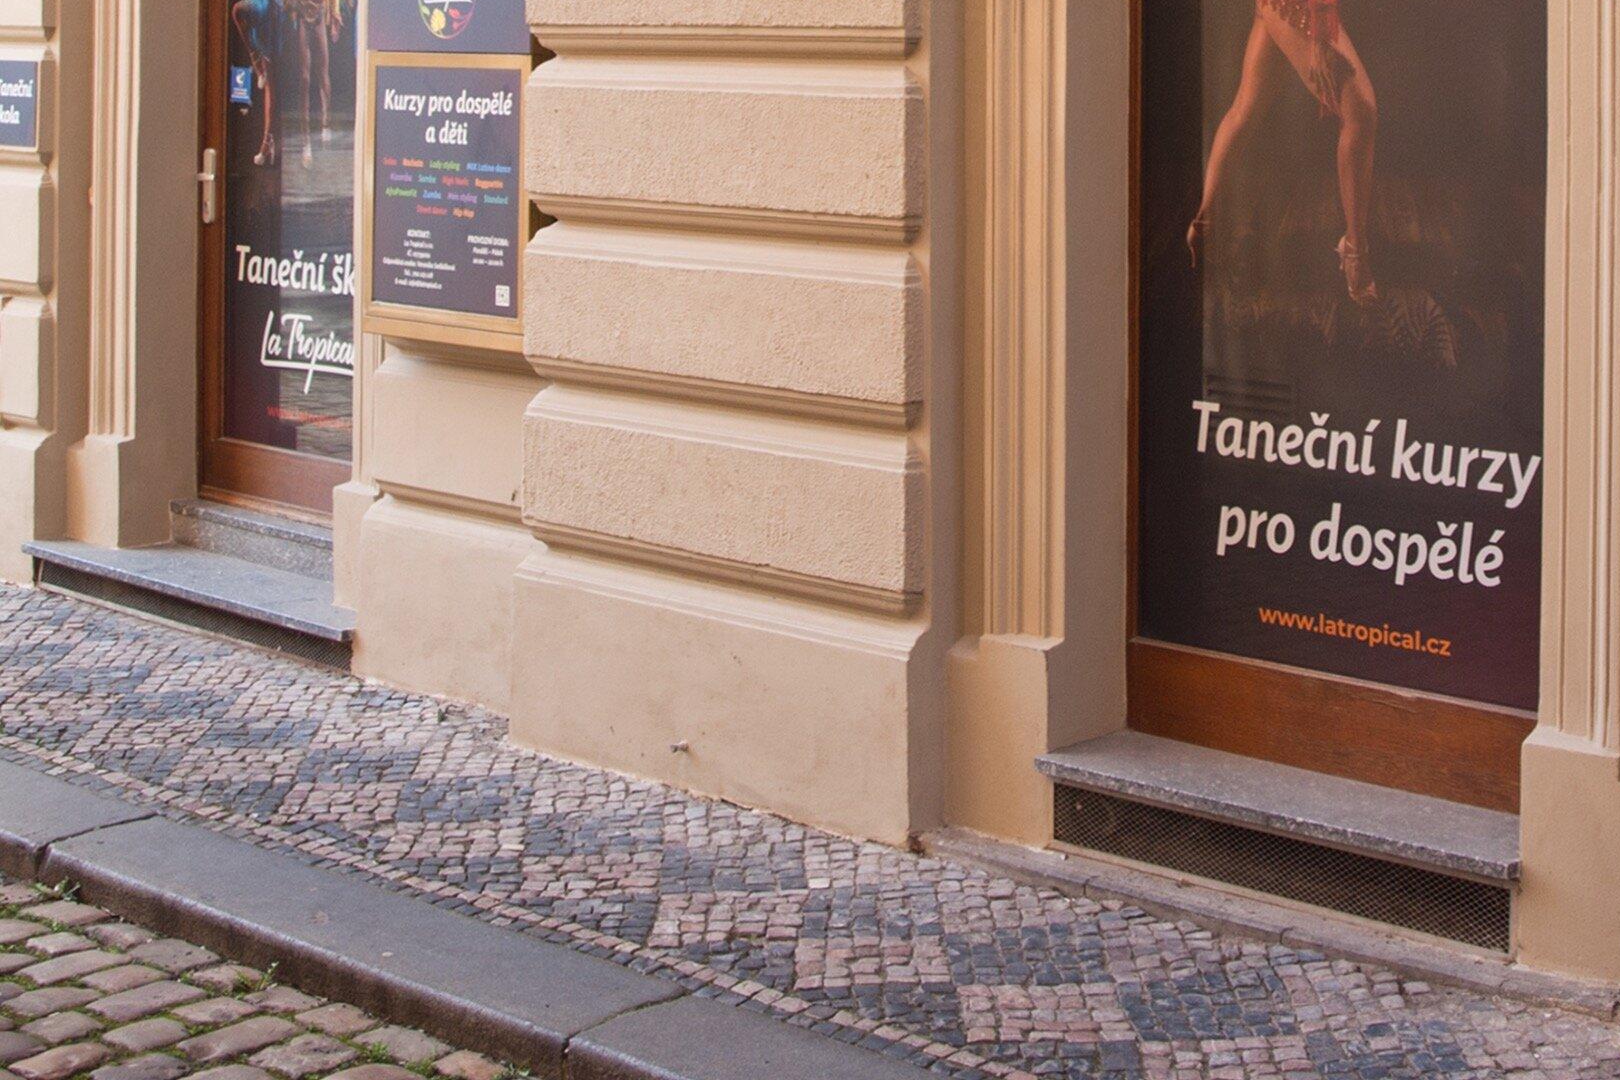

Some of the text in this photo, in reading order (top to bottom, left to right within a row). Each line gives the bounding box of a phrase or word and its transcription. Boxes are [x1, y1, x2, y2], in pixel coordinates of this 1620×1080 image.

[0, 78, 34, 98] aneční
[384, 88, 513, 119] Kurzy pro dospělé
[425, 120, 467, 145] a děti
[236, 245, 328, 292] Taneční
[281, 313, 354, 395] Tropica
[1192, 400, 1541, 509] Taneční kurzy
[1216, 502, 1505, 587] pro dospělé
[1258, 606, 1451, 657] www.latropical.cz
